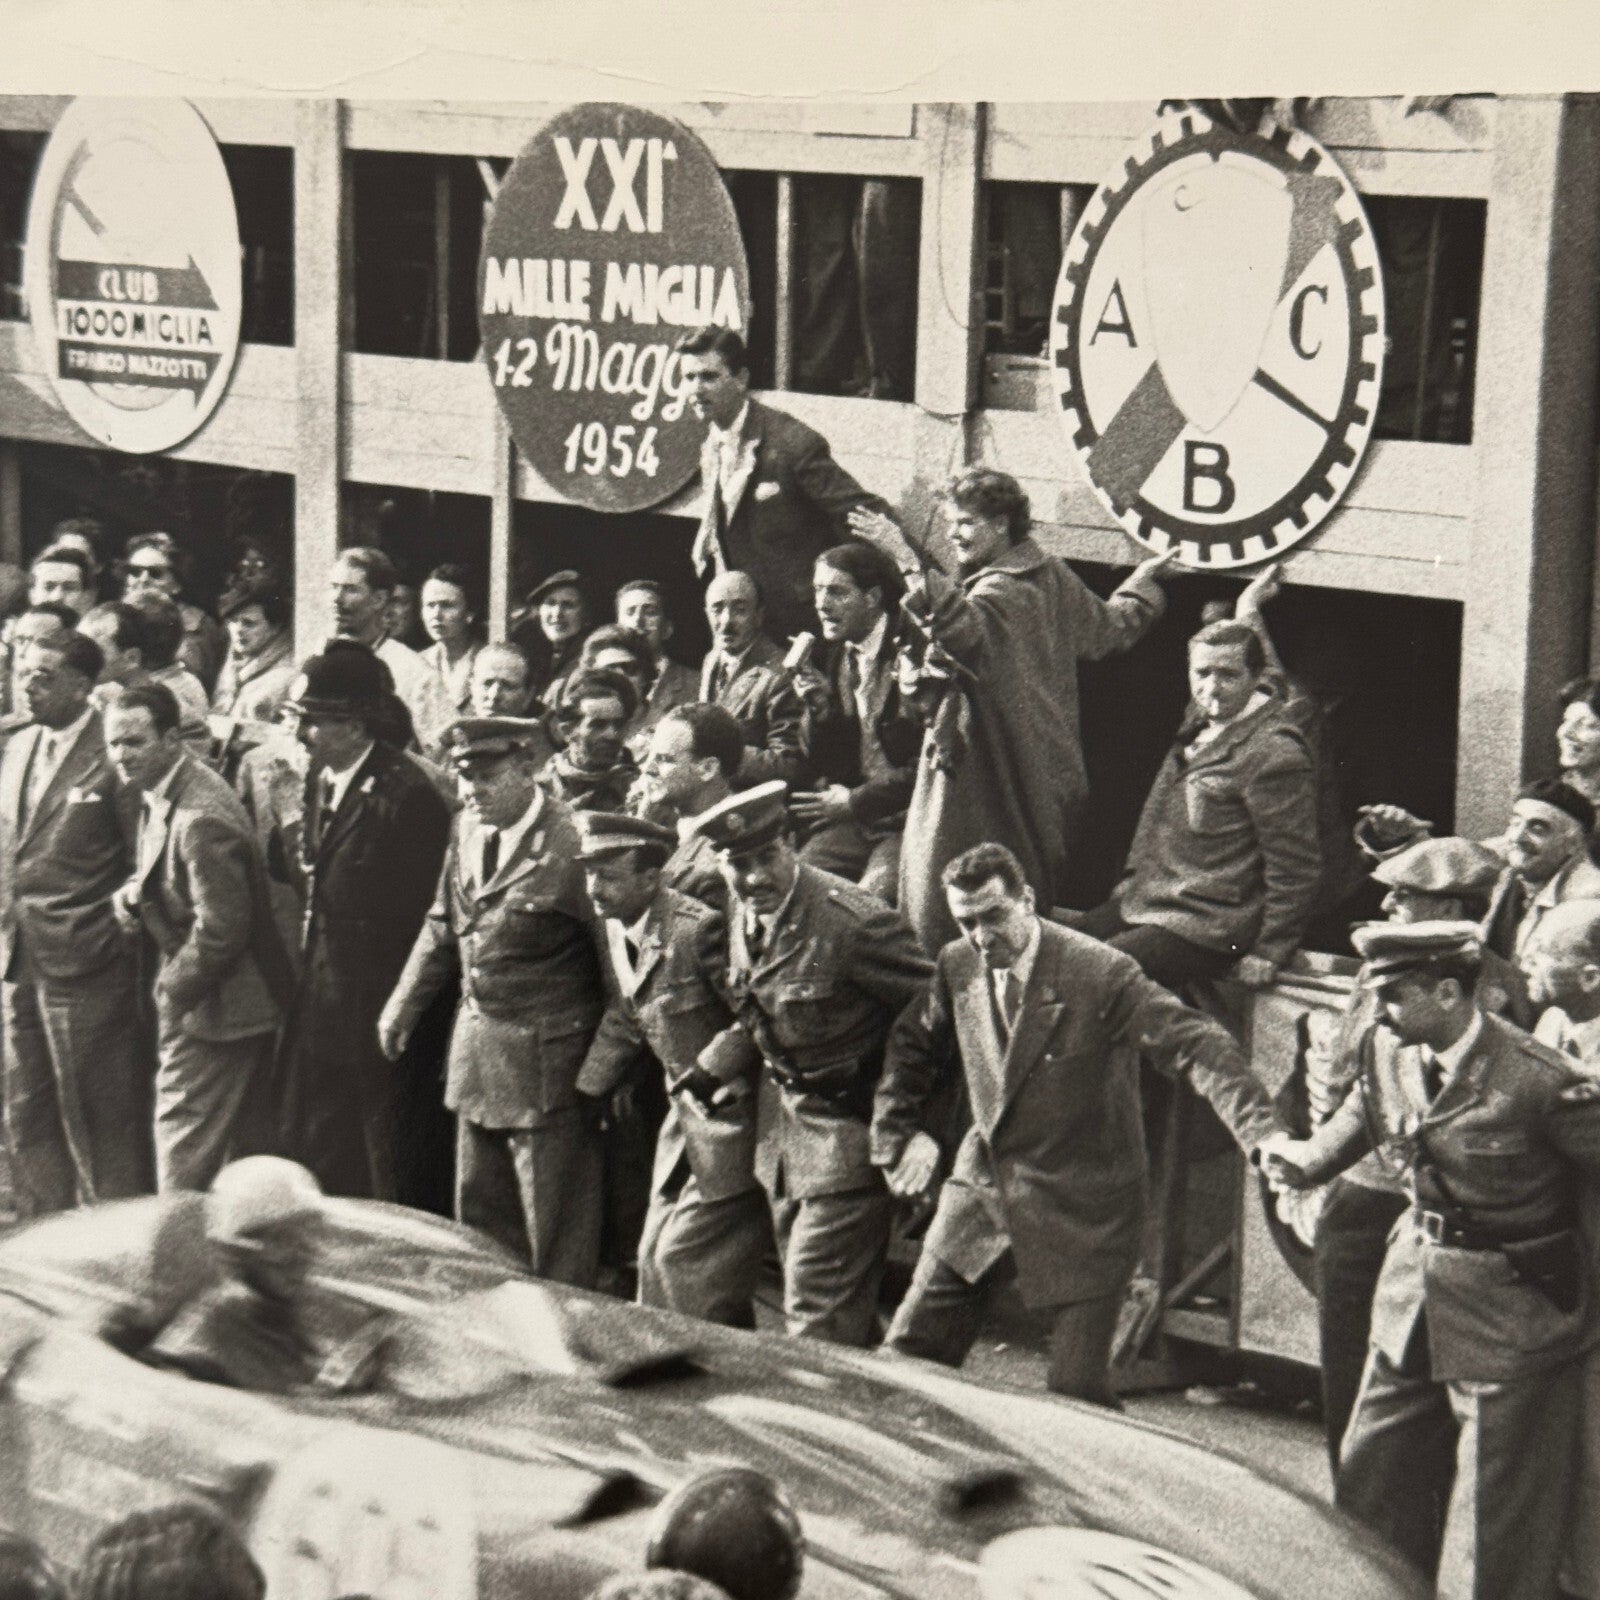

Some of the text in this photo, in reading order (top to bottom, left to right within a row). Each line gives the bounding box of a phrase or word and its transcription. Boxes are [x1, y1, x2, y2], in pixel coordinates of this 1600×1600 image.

[98, 269, 160, 303] CLUB
[483, 256, 741, 330] MILLE MIGLIA
[1088, 277, 1328, 361] A C
[494, 322, 695, 421] 1-2 Magg
[564, 421, 660, 477] 1954
[1182, 440, 1236, 515] B
